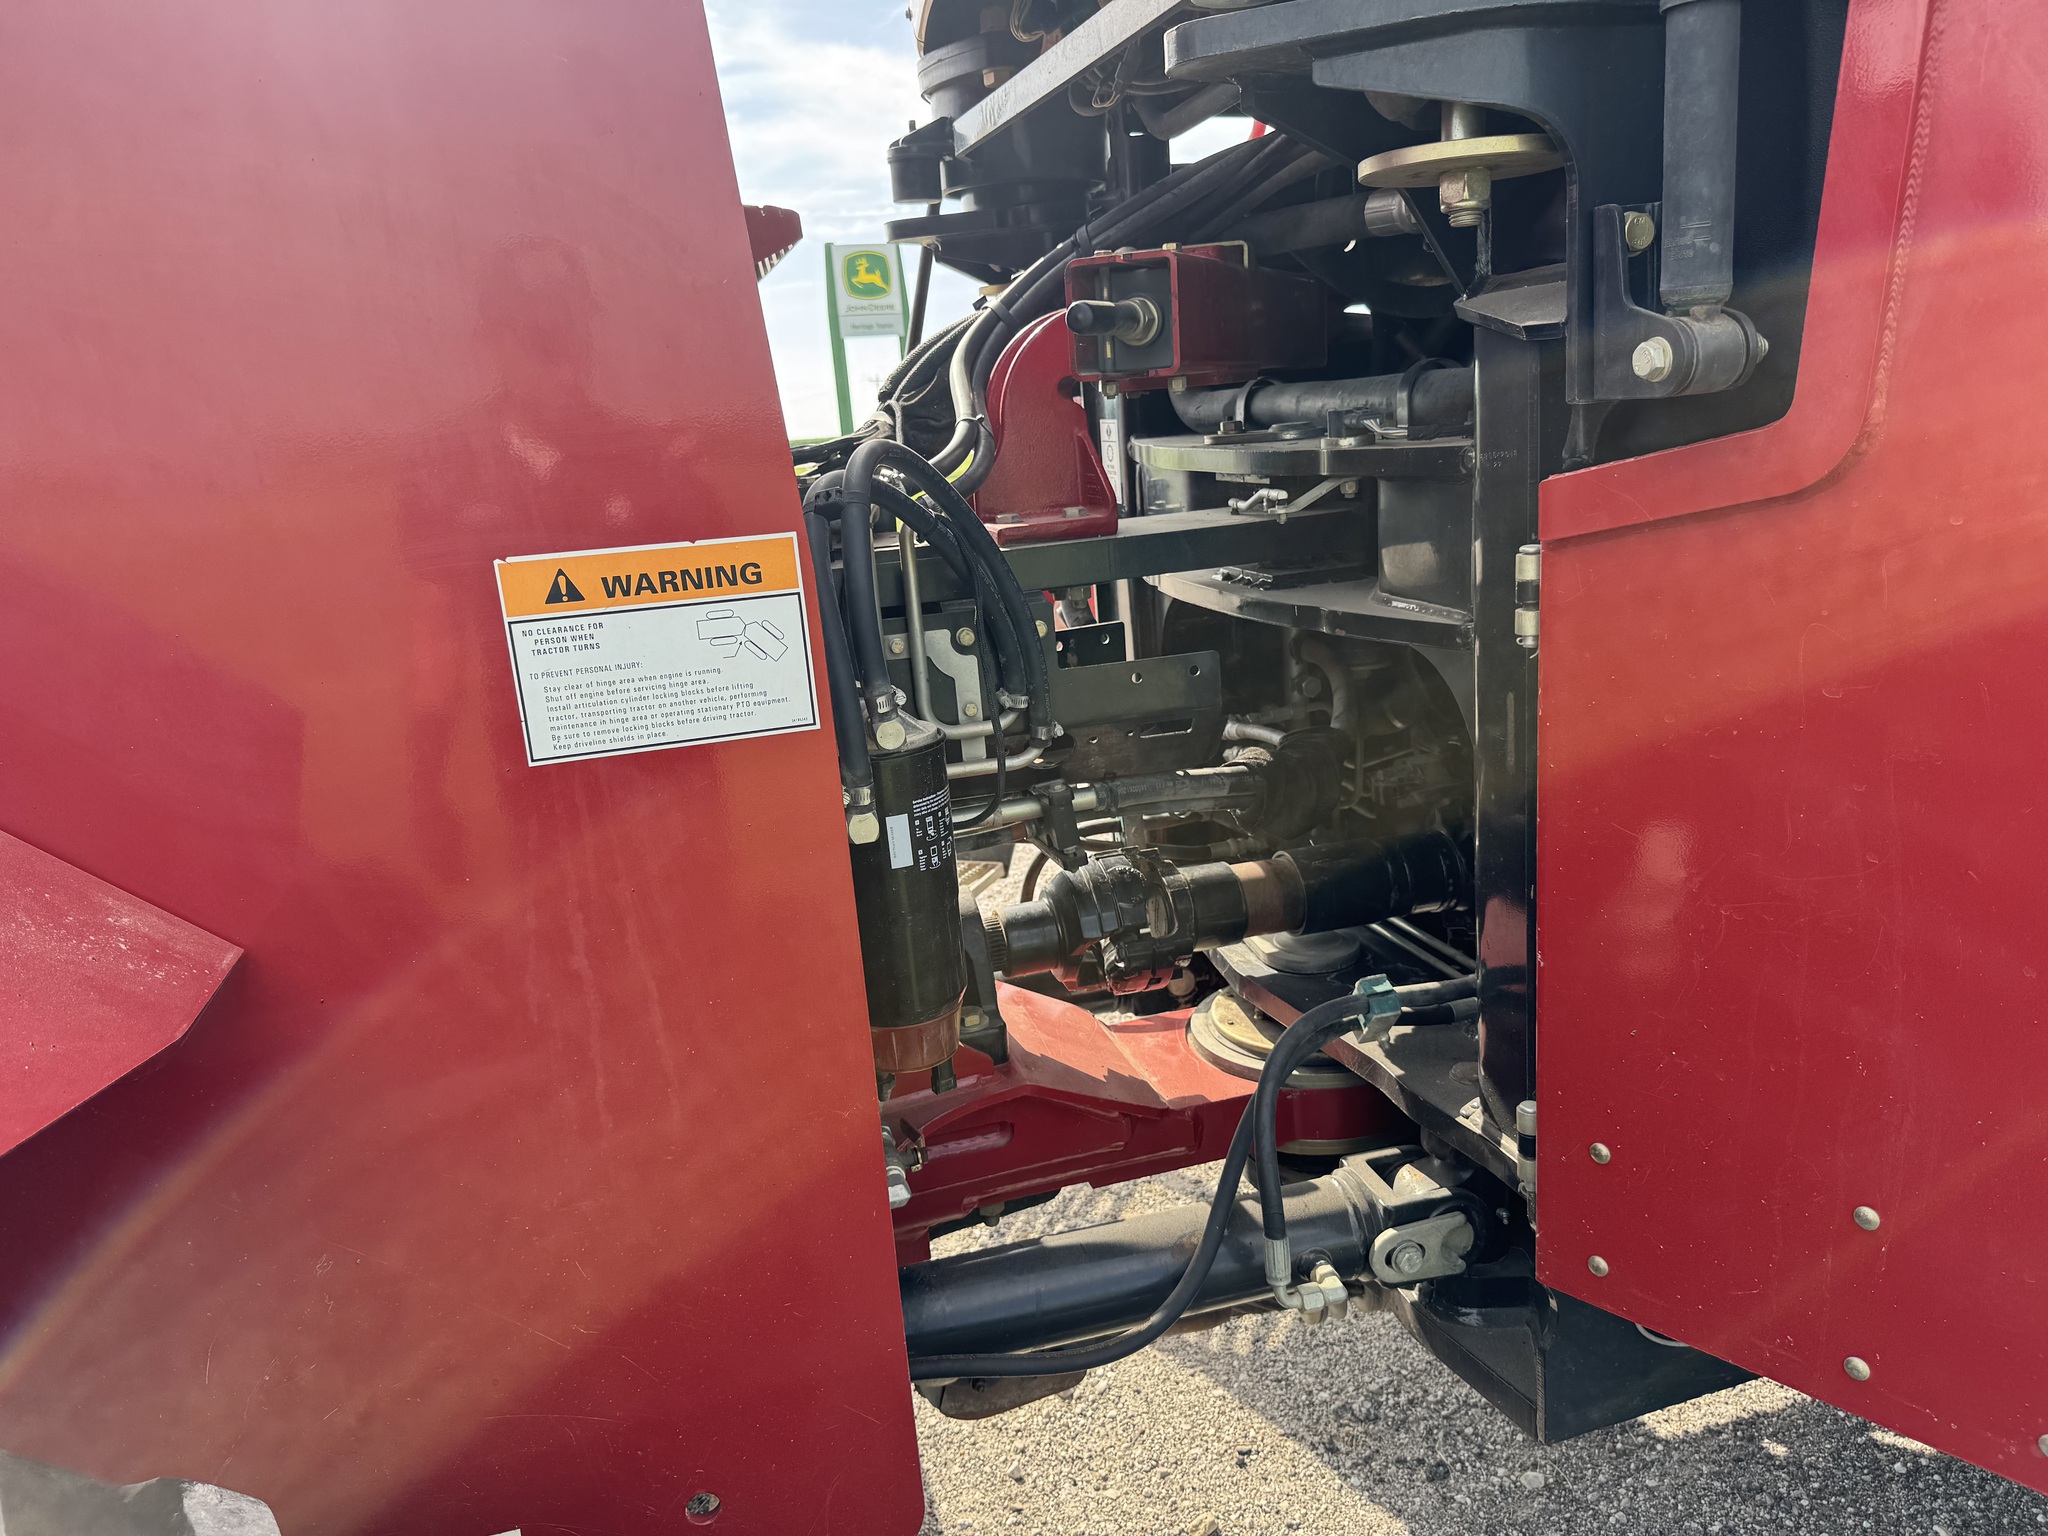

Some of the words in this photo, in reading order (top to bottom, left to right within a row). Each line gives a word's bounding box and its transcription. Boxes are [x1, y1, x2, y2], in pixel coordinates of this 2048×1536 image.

[600, 562, 763, 599] WARNING
[534, 636, 567, 646] PERSON
[570, 633, 595, 642] WHEN
[536, 624, 585, 636] CLEARANCE
[588, 622, 604, 630] FOR
[531, 646, 570, 656] TRACTOR
[573, 643, 601, 652] TURNS
[541, 668, 573, 679] PREVENT
[575, 665, 612, 675] PERSONAL
[614, 661, 643, 671] INJURY:
[543, 685, 561, 694] Stay
[564, 683, 582, 691] clear
[596, 679, 616, 688] hinge
[659, 671, 683, 681] engine
[545, 695, 563, 703] Shut
[580, 691, 604, 699] engine
[607, 687, 630, 696] before
[633, 682, 666, 693] servicing
[669, 679, 688, 688] hinge
[546, 704, 572, 713] Install
[574, 699, 618, 710] articulation
[620, 694, 650, 704] cylinder
[652, 690, 678, 700] locking
[681, 688, 704, 696] blocks
[706, 685, 729, 693] before
[731, 682, 754, 691] lifting
[548, 713, 578, 722] tractor,
[581, 707, 627, 718] transporting
[630, 704, 655, 712] tractor
[669, 698, 696, 707] another
[699, 695, 727, 704] vehicle,
[729, 690, 768, 701] performing
[549, 720, 597, 732] maintenance
[600, 718, 607, 726] in
[609, 716, 629, 725] hinge
[661, 707, 695, 718] operating
[697, 703, 733, 714] stationary
[736, 701, 751, 709] PTO
[753, 696, 791, 707] equipment.
[564, 732, 580, 740] sure
[593, 728, 620, 736] remove
[622, 723, 649, 732] locking
[651, 720, 674, 728] blocks
[677, 717, 700, 725] before
[702, 712, 727, 722] driving
[729, 710, 757, 718] tractor.
[552, 743, 572, 751] Keep
[574, 739, 607, 748] driveline
[609, 735, 635, 744] shields
[646, 731, 669, 740] place.
